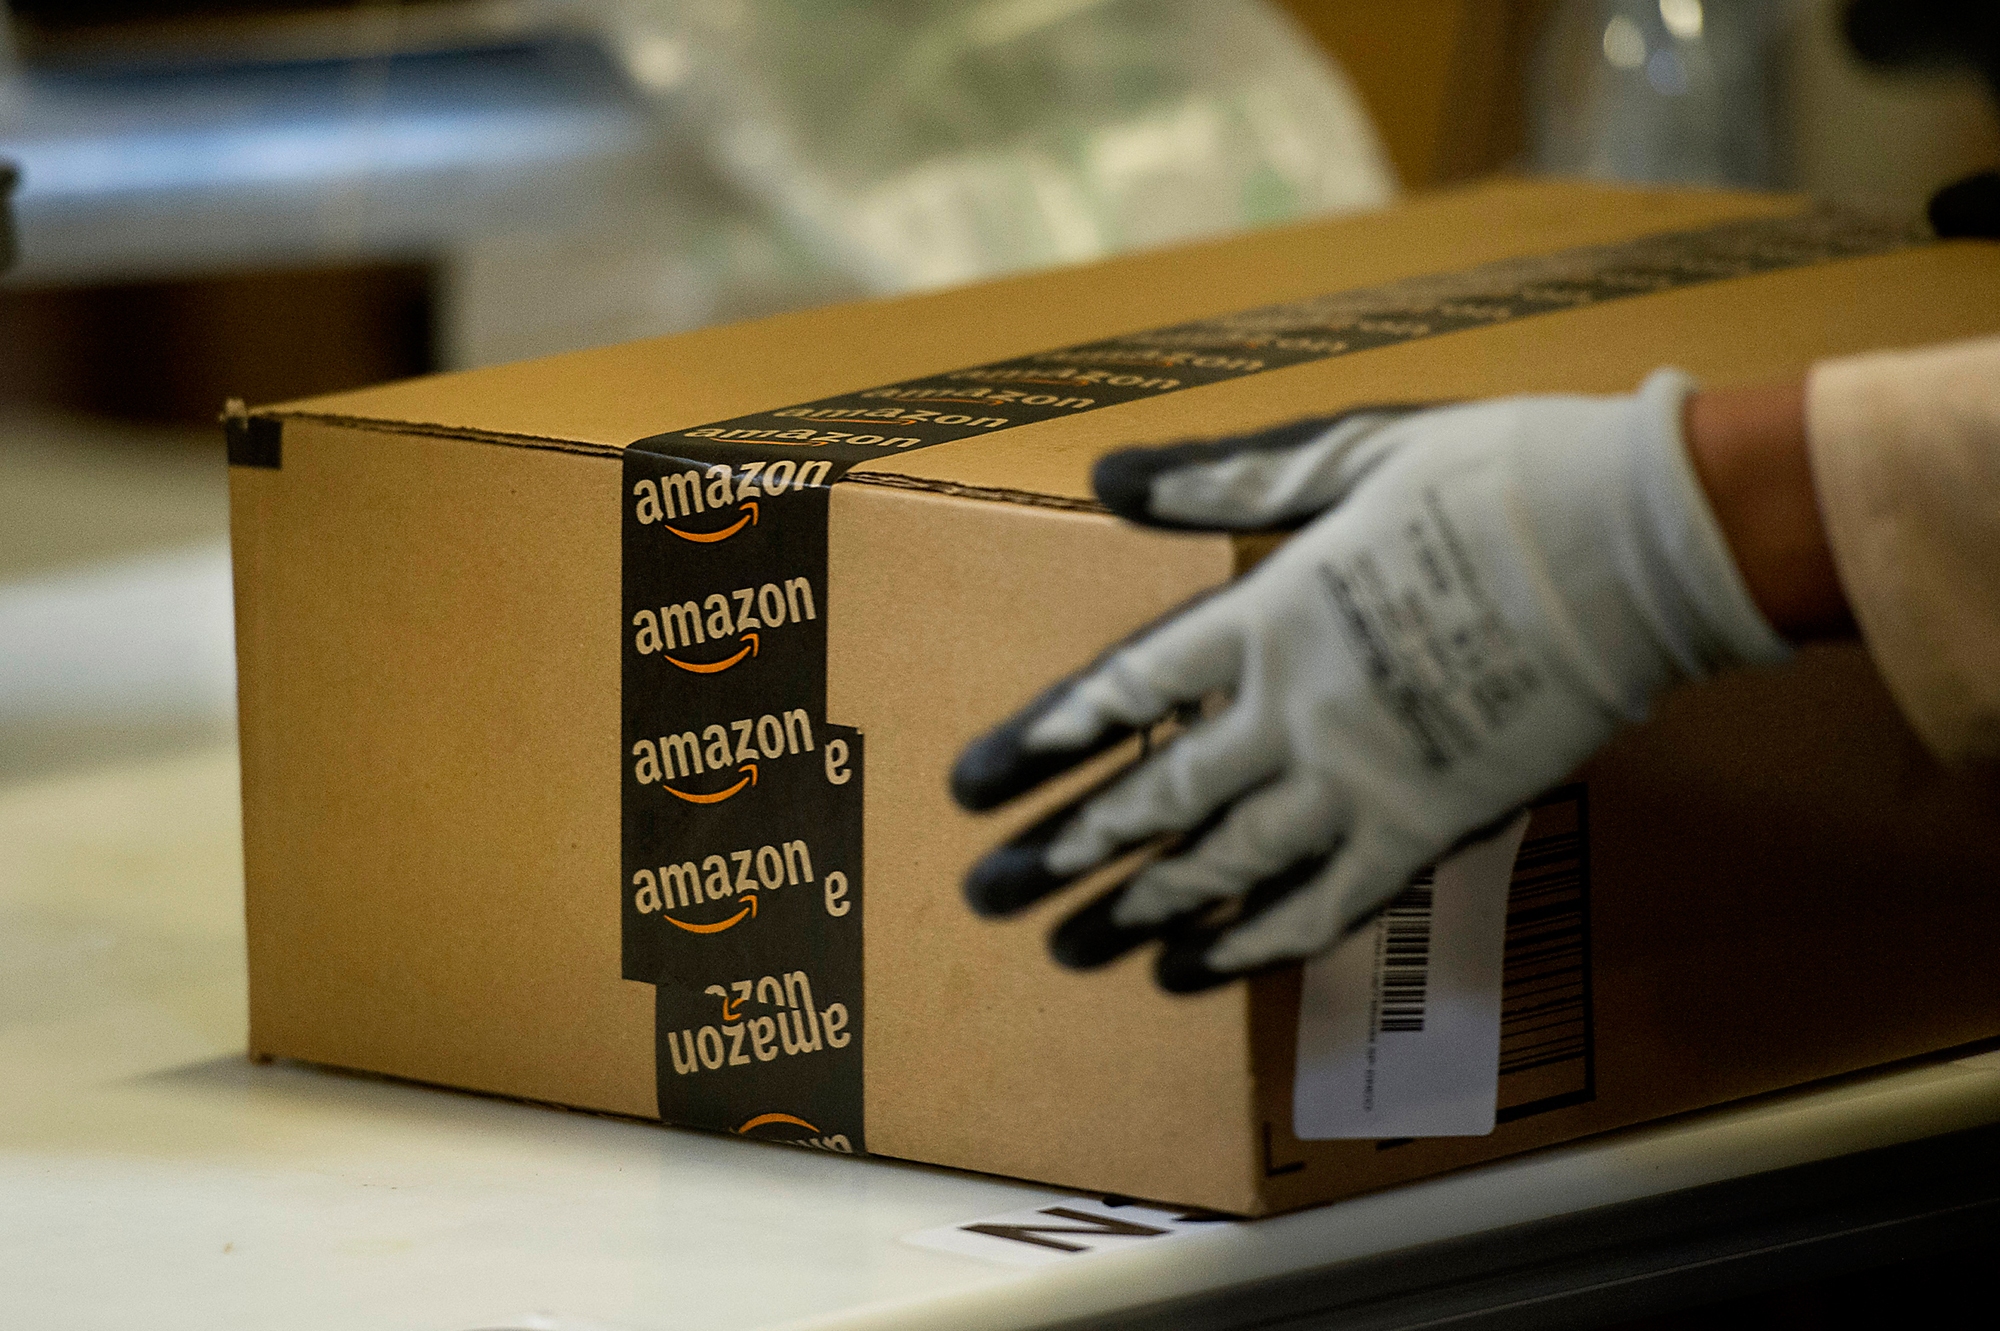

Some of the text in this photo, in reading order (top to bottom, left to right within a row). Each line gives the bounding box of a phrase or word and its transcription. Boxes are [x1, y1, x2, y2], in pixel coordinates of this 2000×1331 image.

[683, 427, 922, 449] amazon
[773, 406, 1010, 428] amazon
[632, 459, 833, 525] amazon
[632, 576, 817, 655] amazon
[632, 708, 815, 785] amazon
[632, 839, 815, 915] amazon
[667, 1002, 852, 1076] amazon
